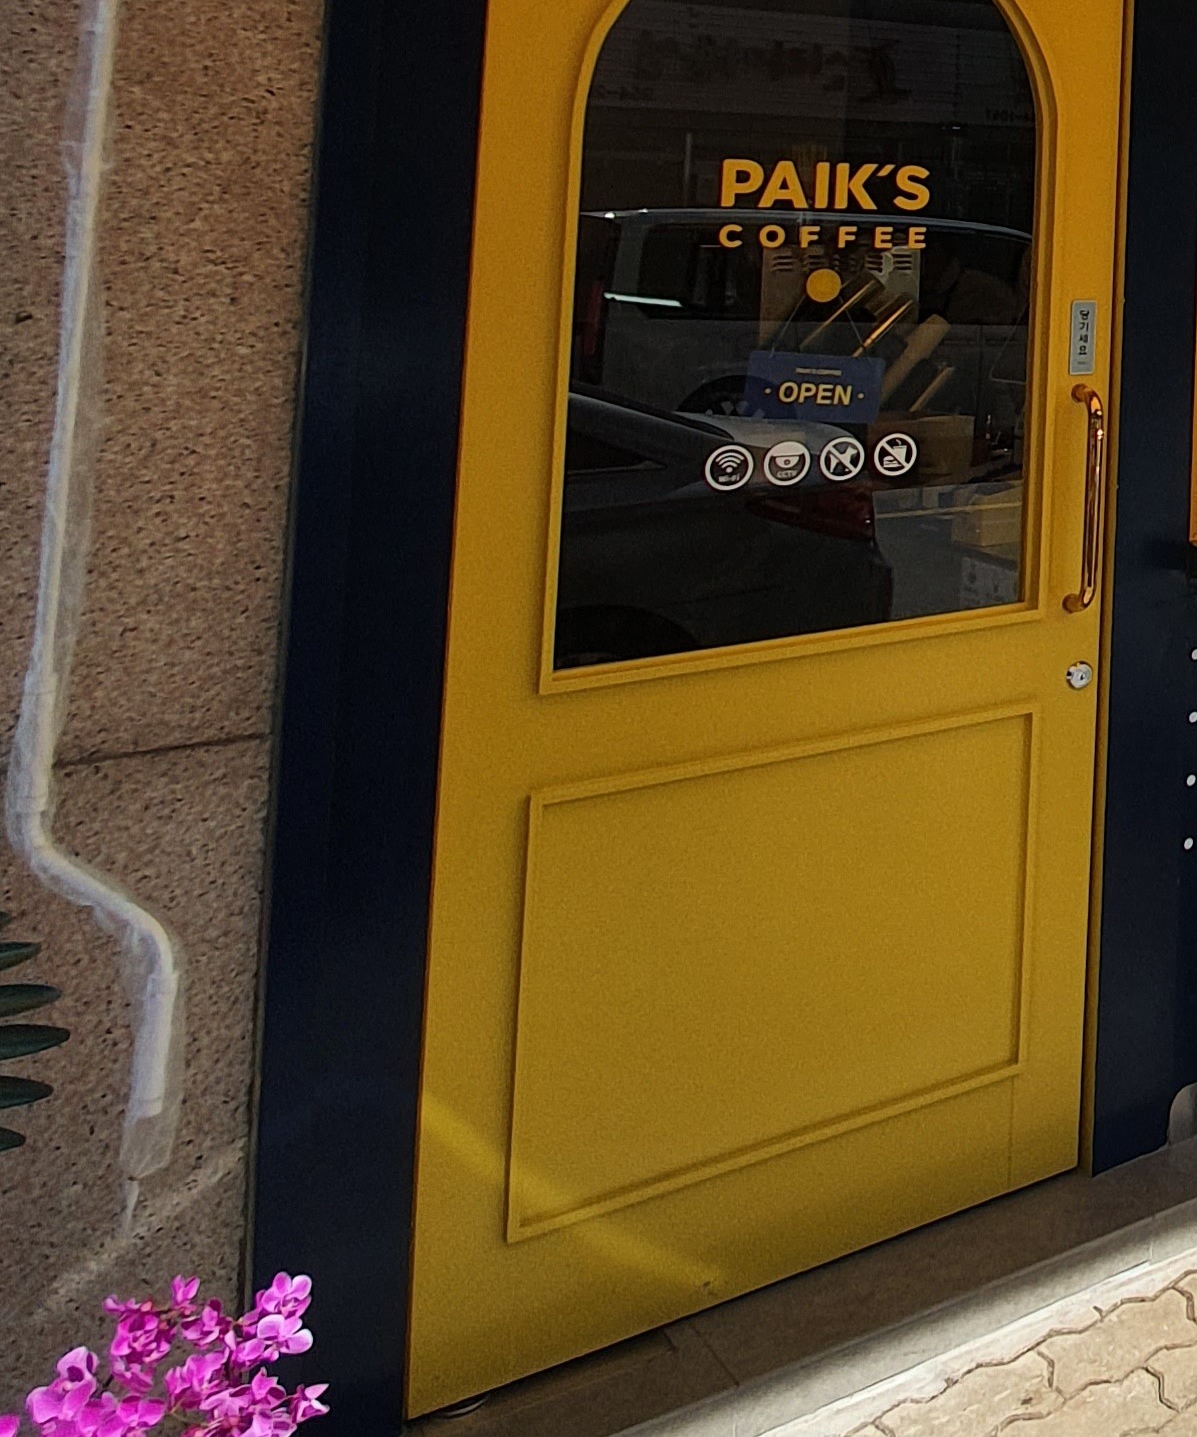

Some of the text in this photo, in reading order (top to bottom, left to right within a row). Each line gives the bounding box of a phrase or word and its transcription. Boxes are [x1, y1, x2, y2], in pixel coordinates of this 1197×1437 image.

[720, 159, 930, 211] PAIK'S
[719, 224, 927, 248] COFFEE
[778, 381, 853, 406] OPEN
